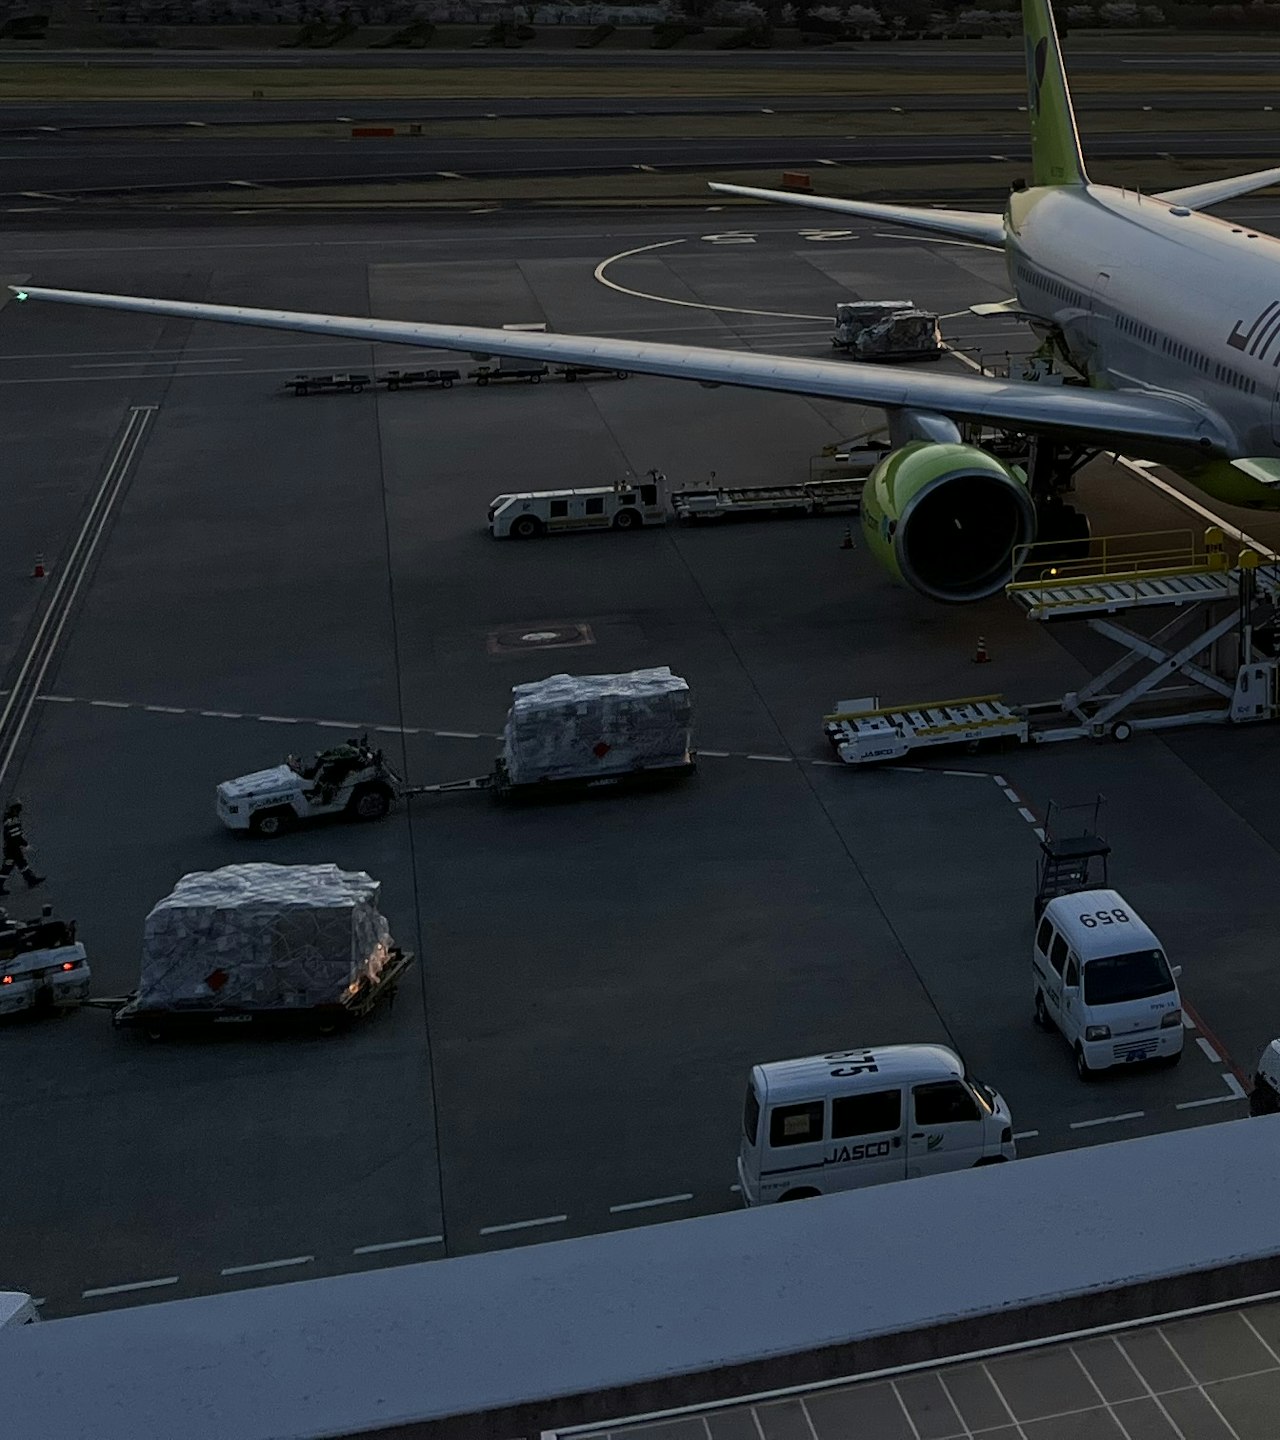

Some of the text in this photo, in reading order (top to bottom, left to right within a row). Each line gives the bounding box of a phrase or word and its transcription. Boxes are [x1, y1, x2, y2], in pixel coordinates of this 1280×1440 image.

[860, 748, 893, 759] JASCO
[1079, 908, 1130, 928] 859
[824, 1141, 890, 1164] JASCO
